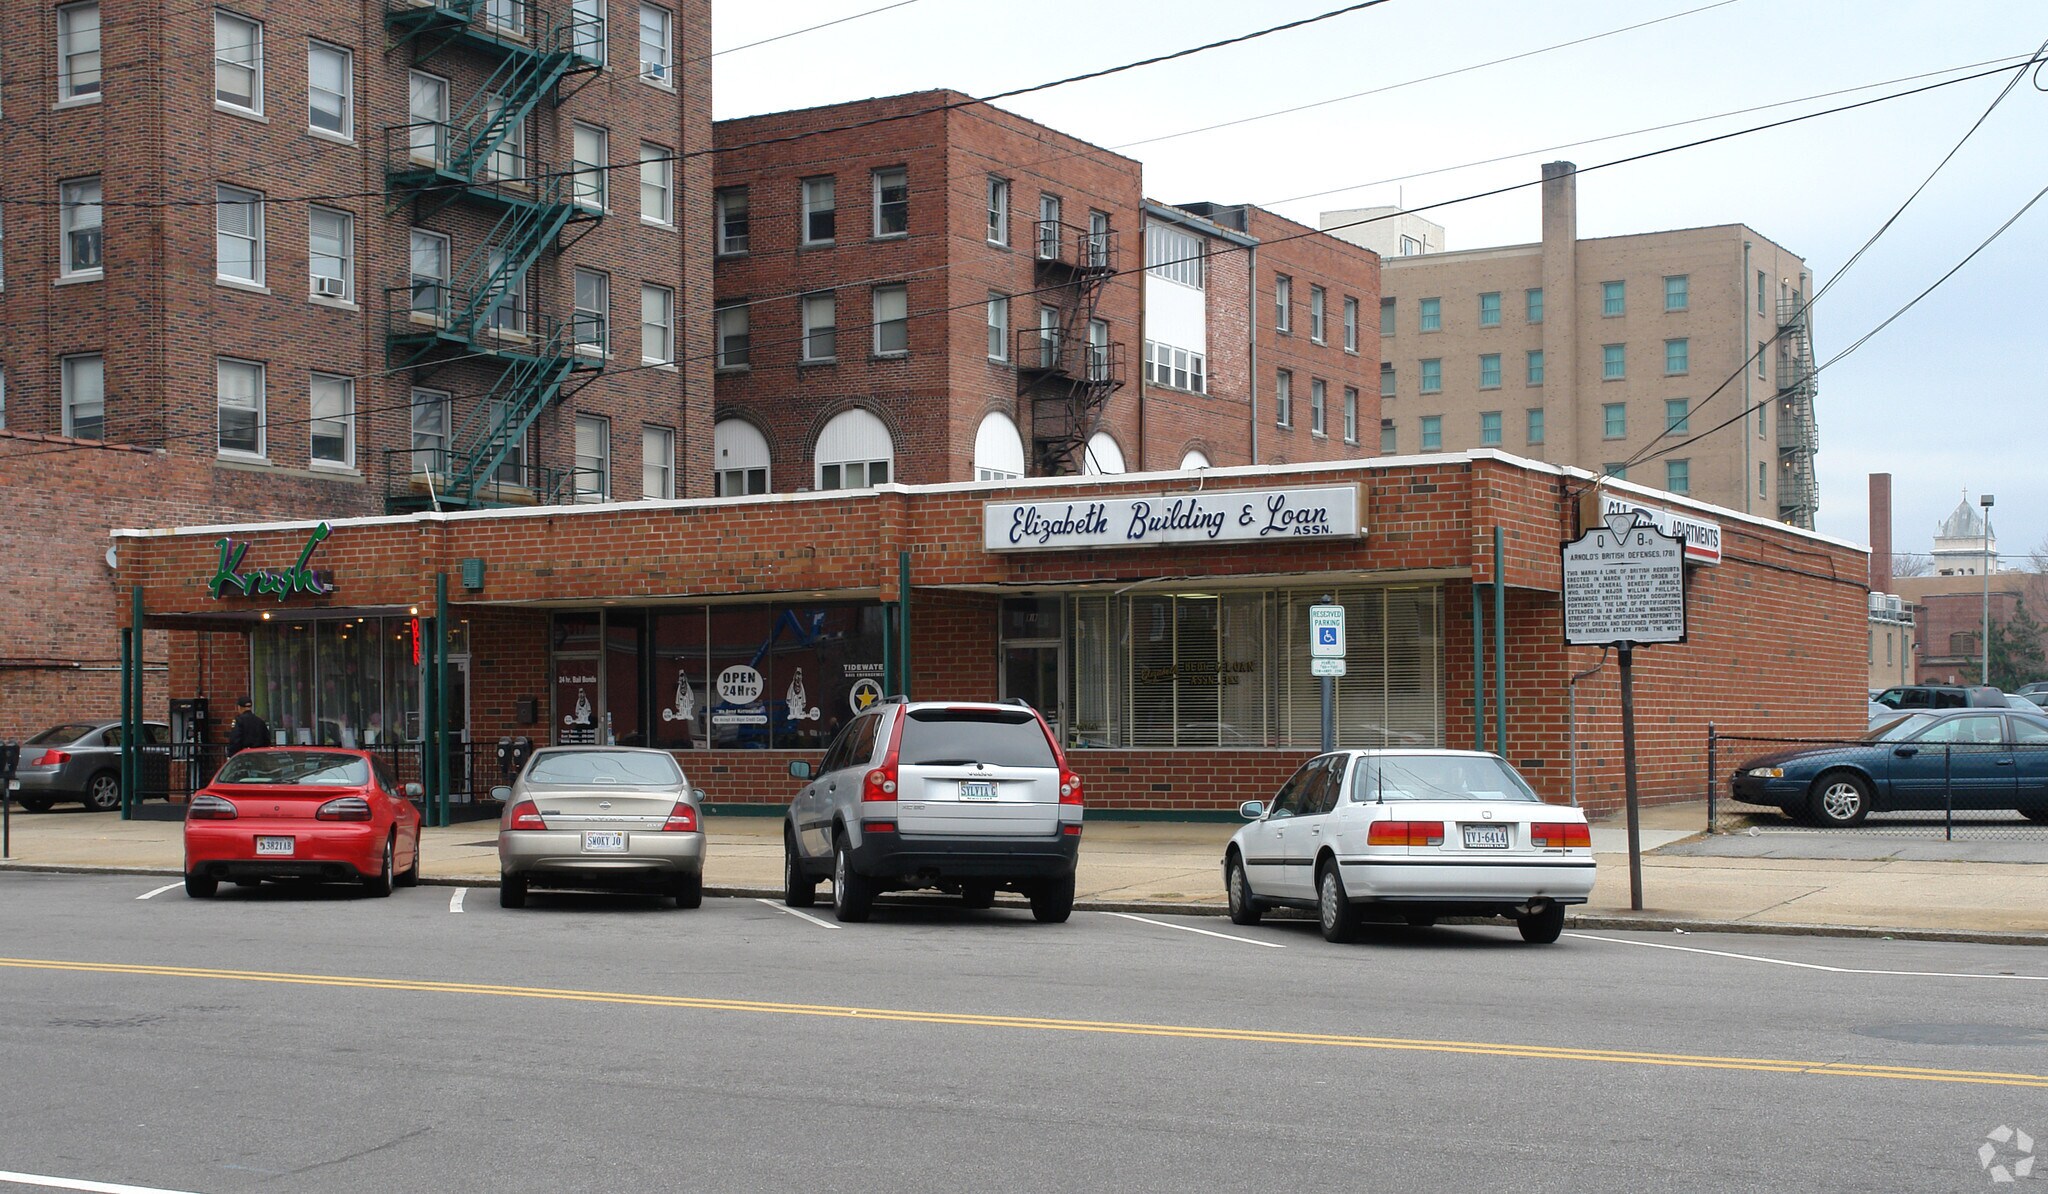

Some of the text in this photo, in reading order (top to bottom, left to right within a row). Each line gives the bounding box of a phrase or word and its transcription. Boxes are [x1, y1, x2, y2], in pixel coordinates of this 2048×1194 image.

[1009, 494, 1328, 544] Elizabeth Building & Loan
[1293, 524, 1334, 536] ASSN.
[1672, 520, 1718, 548] APARTMENTS
[1597, 535, 1604, 548] Q
[1628, 551, 1661, 559] DEFENSES,
[208, 522, 333, 602] Krush
[411, 618, 420, 667] OPEN
[723, 672, 756, 683] OPEN
[723, 685, 757, 696] 24Hrs
[961, 785, 989, 797] SYLVIA
